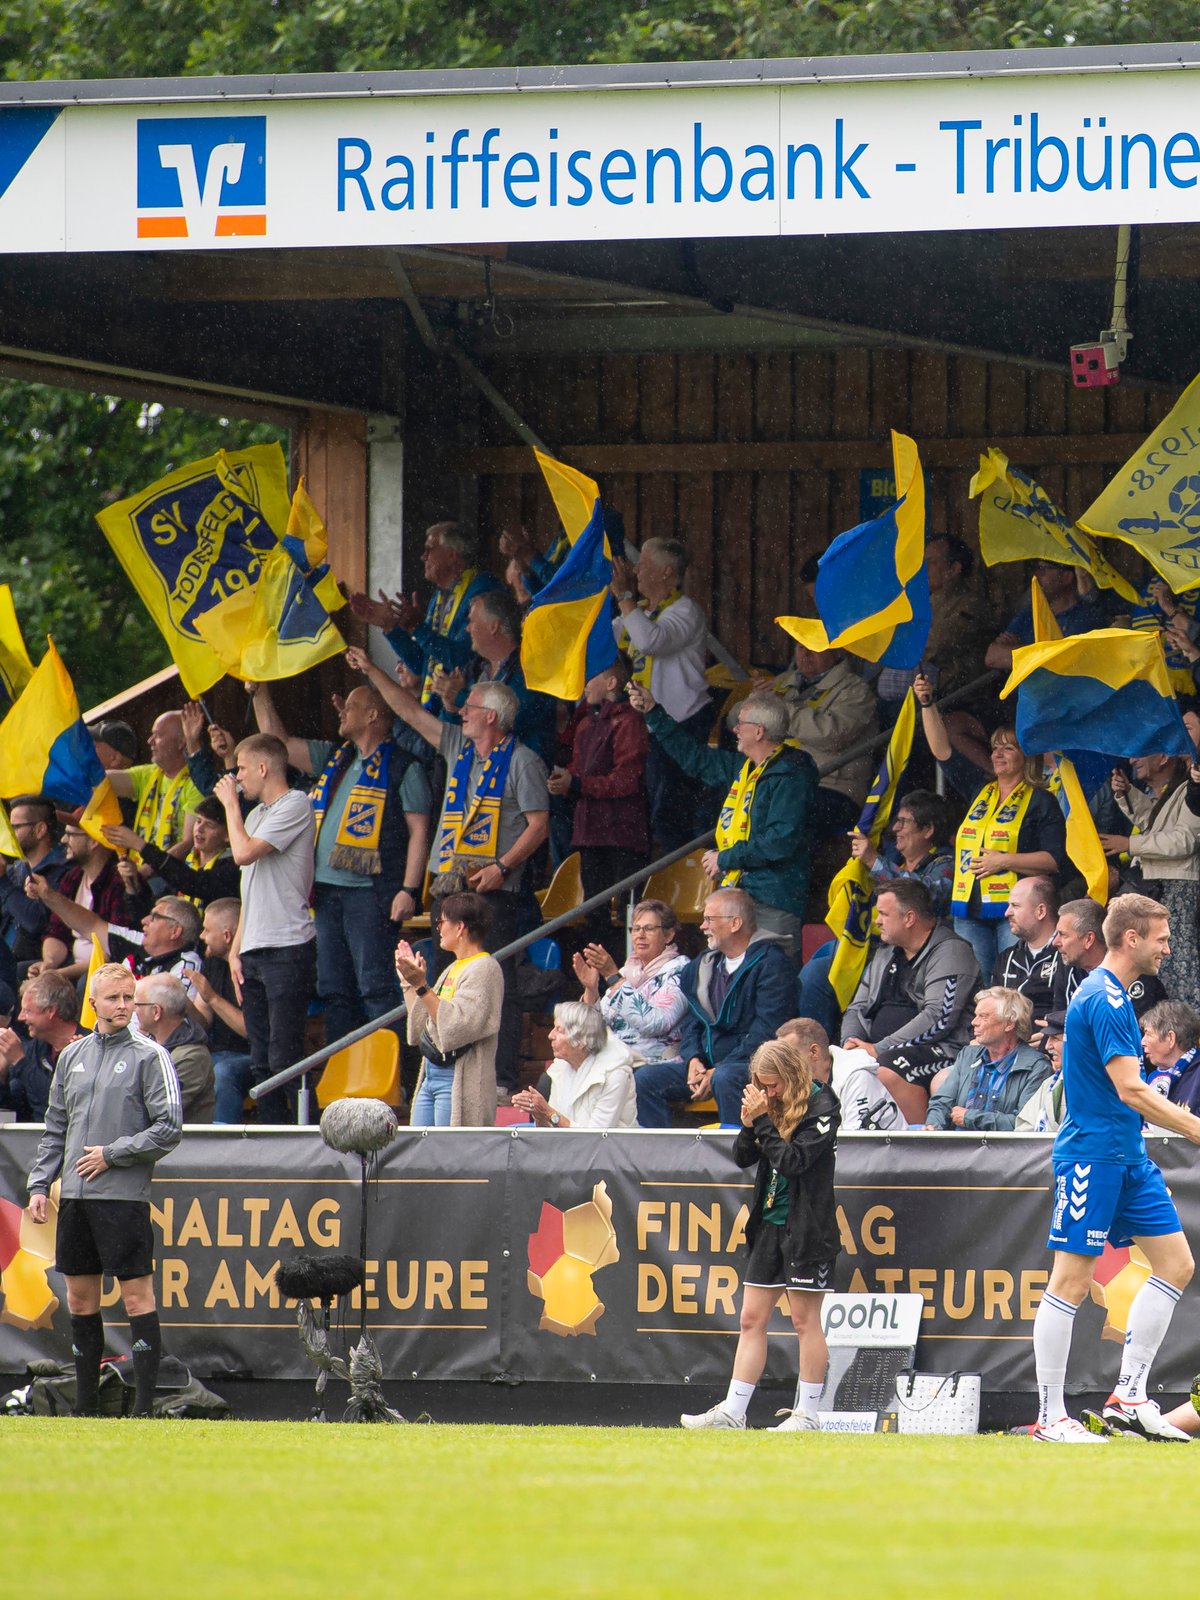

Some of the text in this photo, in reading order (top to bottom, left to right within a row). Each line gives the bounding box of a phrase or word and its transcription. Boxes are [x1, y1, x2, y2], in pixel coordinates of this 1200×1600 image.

[336, 119, 870, 213] Raiffeisenbank
[939, 112, 1200, 194] Tribüne
[150, 500, 189, 546] SV
[892, 1056, 911, 1069] ST
[151, 1197, 341, 1248] NALTAG
[203, 1259, 489, 1311] AMEURE
[636, 1262, 737, 1315] DER
[825, 1297, 899, 1338] pohl
[820, 1418, 872, 1432] vtodesfelde
